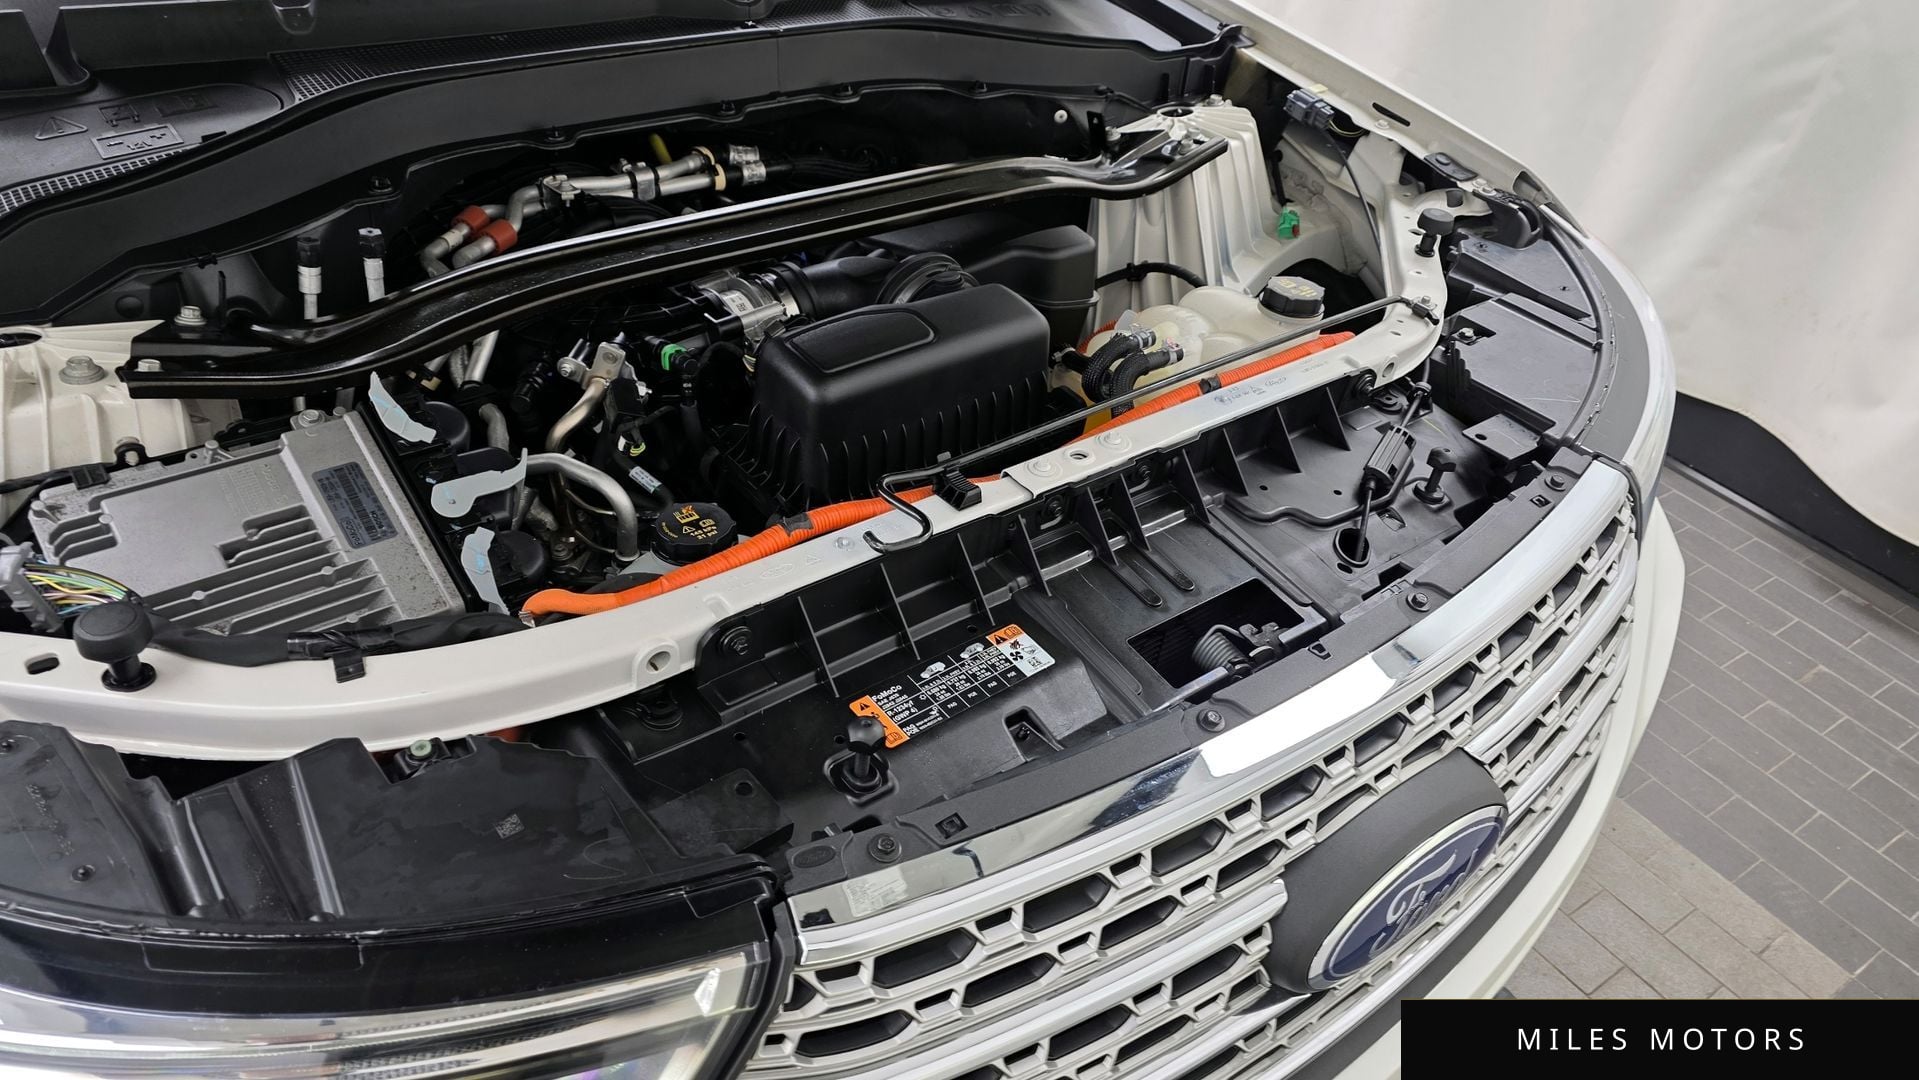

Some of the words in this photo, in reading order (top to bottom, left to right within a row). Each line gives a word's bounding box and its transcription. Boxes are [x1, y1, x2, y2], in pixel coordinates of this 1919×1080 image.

[872, 685, 902, 702] FoMoCo
[886, 700, 914, 716] R-1234yf
[892, 710, 910, 722] (GWP
[1368, 849, 1479, 959] Ford
